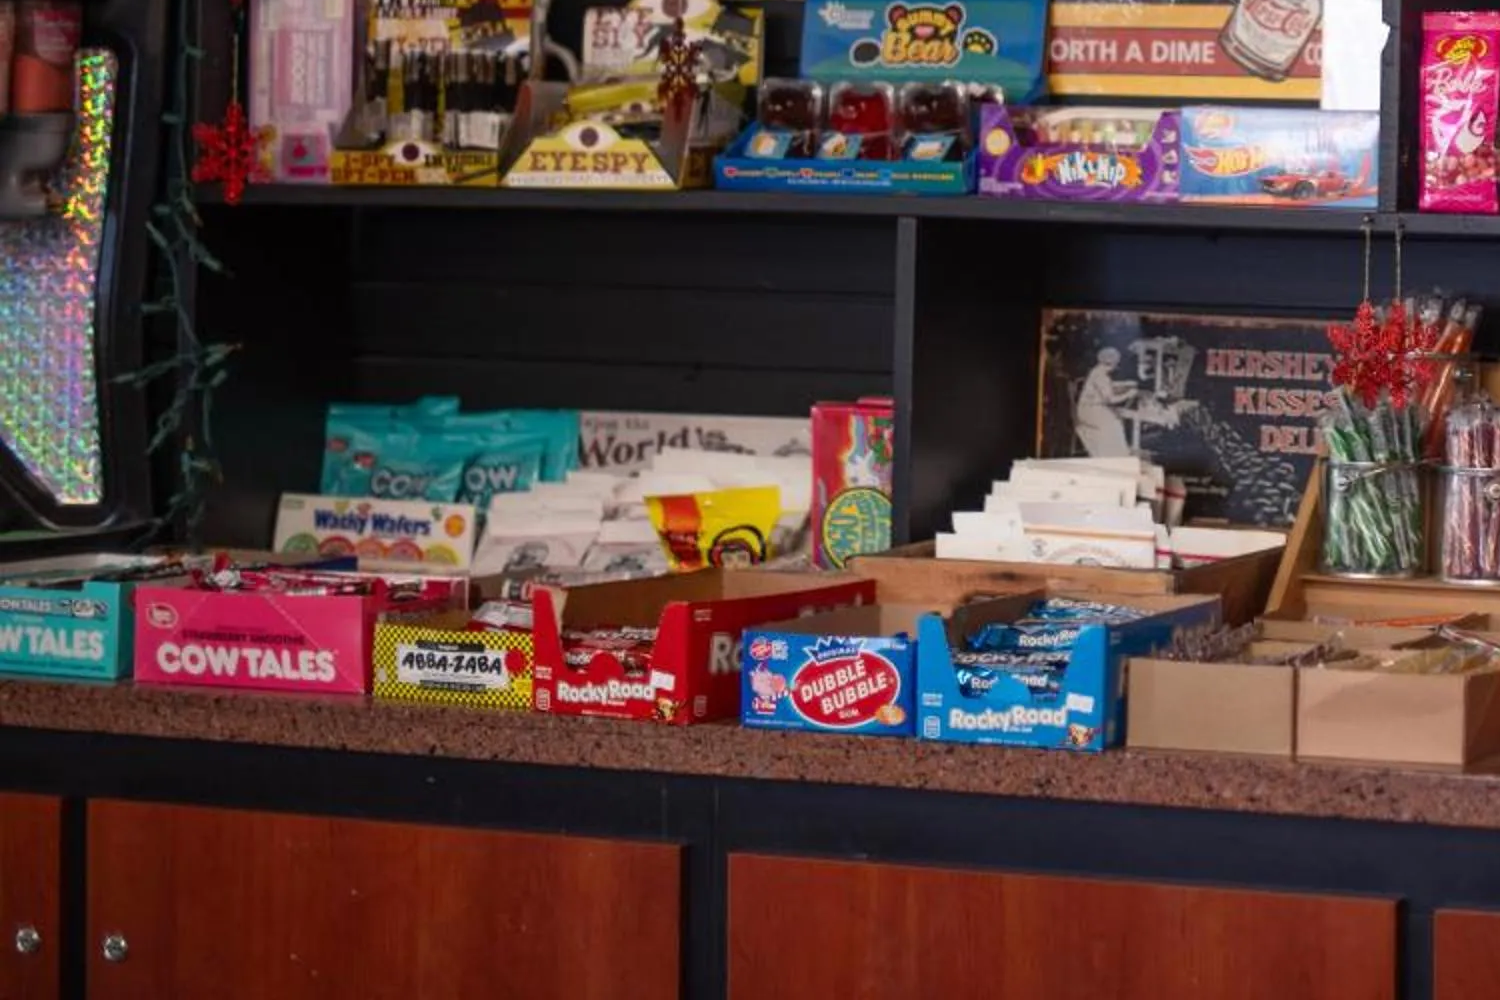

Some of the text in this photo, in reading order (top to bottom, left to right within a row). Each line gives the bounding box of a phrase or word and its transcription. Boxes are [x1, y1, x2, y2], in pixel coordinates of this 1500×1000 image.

[1124, 41, 1145, 62] A
[1151, 41, 1216, 64] DIME
[314, 509, 431, 536] Wacky Wafers
[28, 628, 104, 660] TALES
[157, 641, 337, 683] COW TALES
[402, 652, 502, 675] ABBA-ZABA
[801, 659, 866, 703] DUBBLE
[821, 672, 888, 716] BUBBLE
